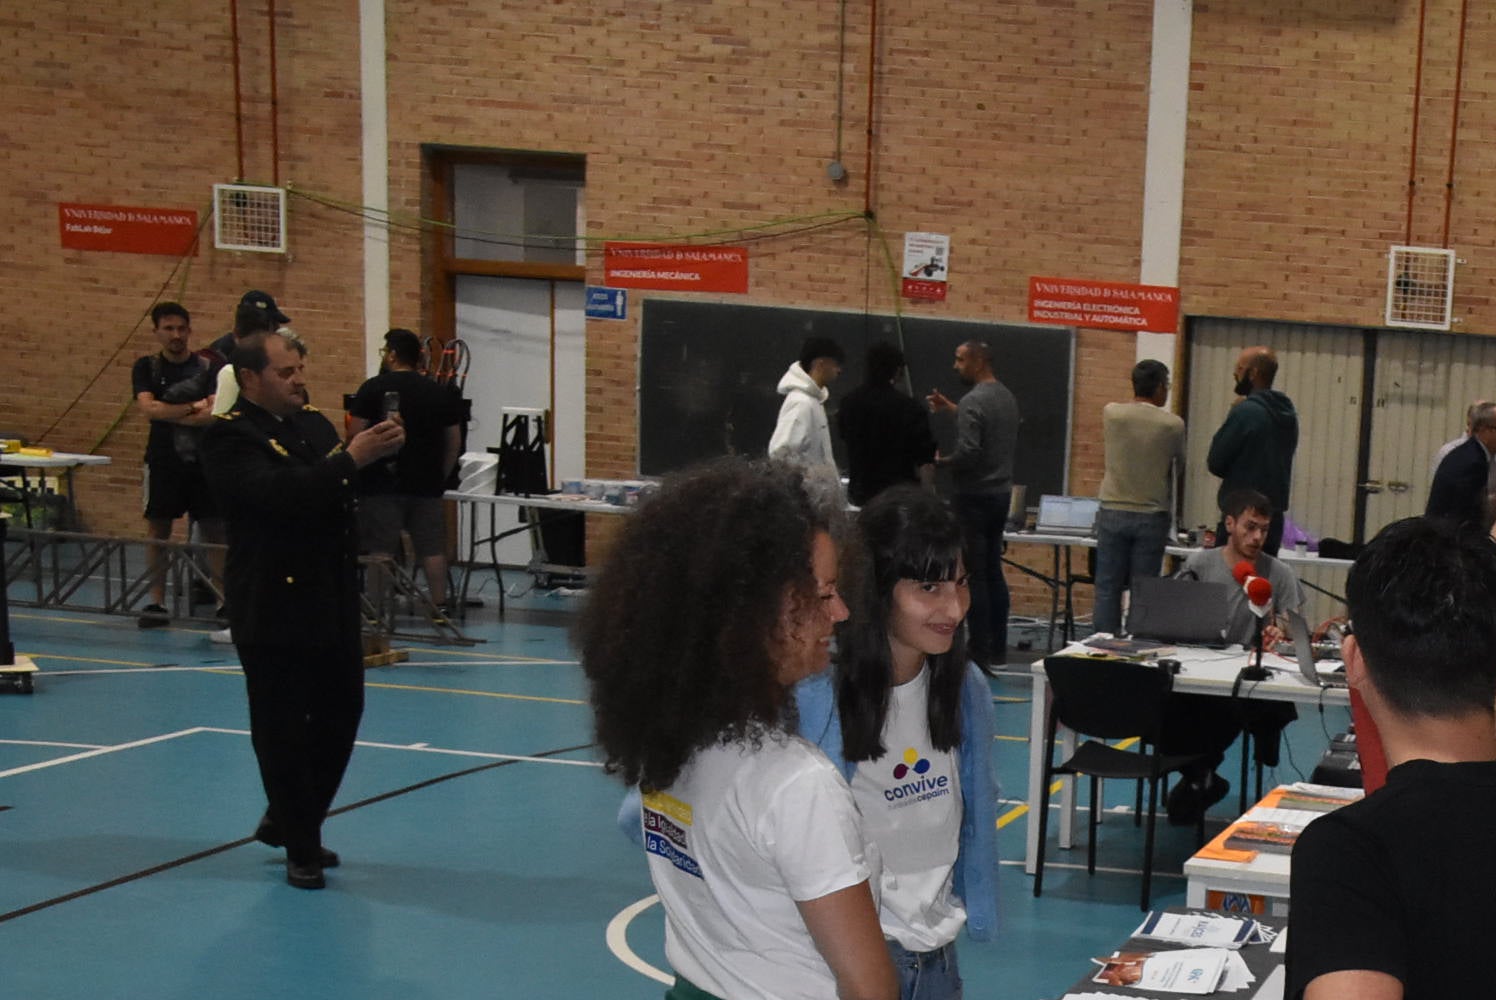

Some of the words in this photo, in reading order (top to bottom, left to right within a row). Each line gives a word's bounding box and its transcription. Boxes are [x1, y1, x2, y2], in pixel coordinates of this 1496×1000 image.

[657, 271, 702, 281] MECÁNICA
[1112, 288, 1174, 303] SALAMANCA
[1033, 310, 1083, 321] INDUSTRIAL
[1082, 302, 1141, 315] ELECTRÓNICA
[884, 775, 948, 802] convive
[647, 835, 657, 850] la
